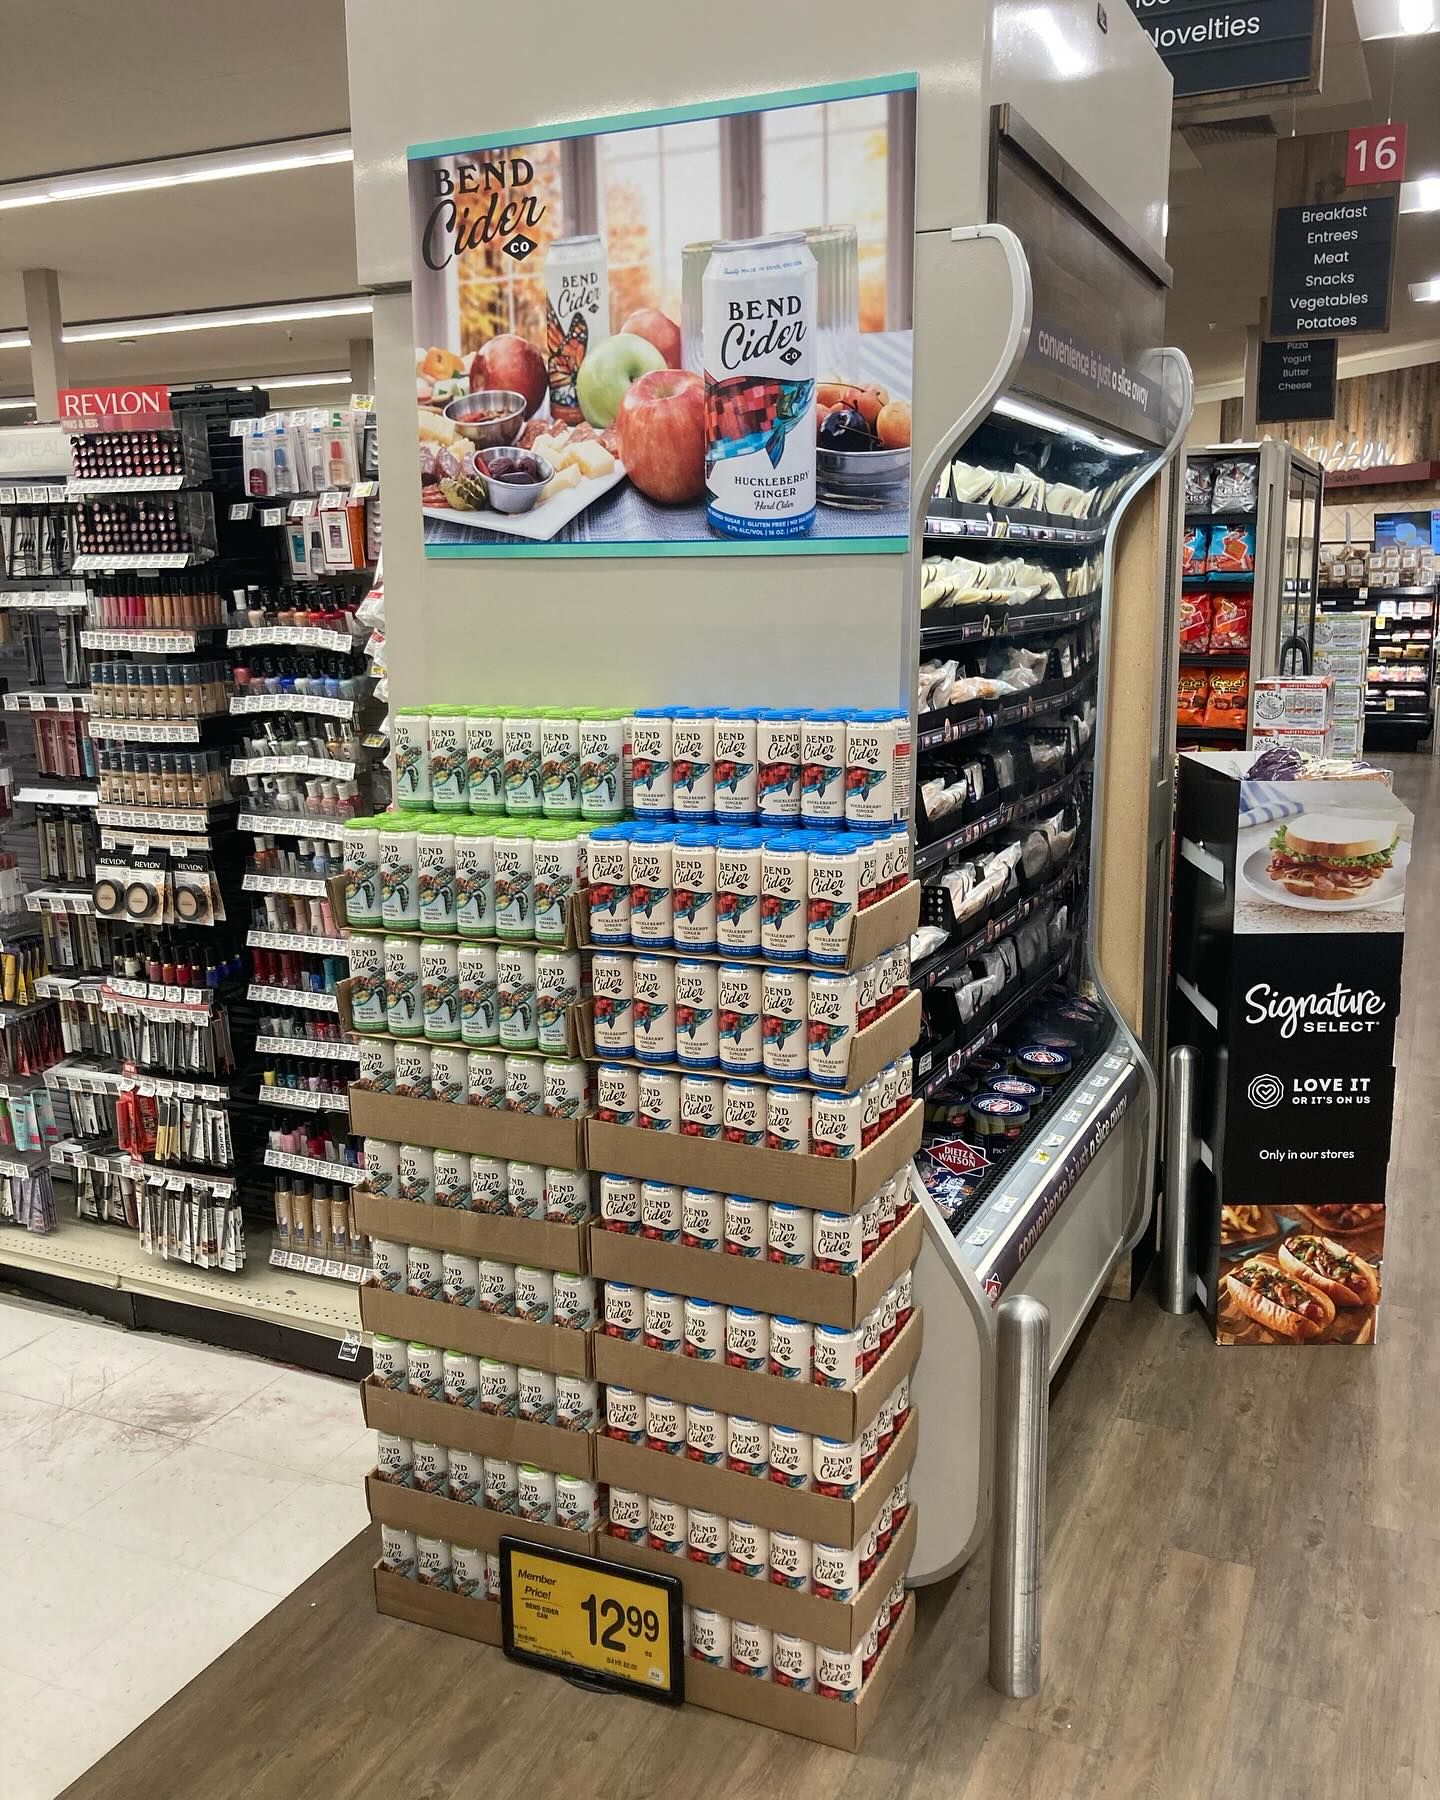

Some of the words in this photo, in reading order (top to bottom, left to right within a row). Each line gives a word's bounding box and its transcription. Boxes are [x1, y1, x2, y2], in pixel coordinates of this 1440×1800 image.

[1144, 15, 1260, 48] Novelties
[1355, 137, 1396, 171] 16
[433, 159, 533, 196] BEND
[1302, 206, 1367, 223] Breakfast
[423, 192, 546, 270] Cider
[1308, 230, 1358, 244] Entrees
[511, 242, 529, 253] CO
[1314, 251, 1349, 264] Meat
[562, 272, 598, 288] BEND
[1306, 272, 1354, 286] Snacks
[558, 287, 601, 318] Cider
[728, 296, 801, 320] BEND
[1290, 293, 1368, 311] Vegetables
[1297, 316, 1357, 330] Potatoes
[721, 320, 807, 369] Cider
[786, 352, 797, 360] CO
[1283, 354, 1312, 365] Yogurt
[1039, 331, 1089, 376] convenience
[1090, 351, 1096, 380] is
[1097, 354, 1111, 389] just
[1112, 371, 1117, 390] a
[1118, 368, 1131, 398] slice
[1132, 382, 1149, 412] away
[1283, 368, 1310, 377] Butter
[1279, 382, 1312, 391] Cheese
[65, 392, 160, 416] REVLON
[735, 471, 809, 486] HUCKLEBERRY
[754, 488, 796, 498] GINGER
[754, 501, 774, 510] Hard
[776, 500, 793, 510] Cider
[635, 731, 659, 740] BEND
[718, 732, 744, 740] BEND
[806, 735, 833, 743] BEND
[851, 738, 878, 746] BEND
[633, 739, 662, 755] Cider
[717, 741, 746, 757] Cider
[804, 744, 835, 761] Cider
[848, 746, 880, 764] Cider
[594, 855, 622, 863] BEND
[676, 860, 701, 869] BEND
[178, 863, 203, 871] REVLON
[592, 862, 625, 880] Cider
[720, 863, 747, 871] BEND
[814, 869, 842, 878] BEND
[674, 868, 704, 885] Cider
[718, 870, 749, 889] Cider
[811, 877, 845, 895] Cider
[722, 982, 748, 991] BEND
[720, 990, 750, 1006] Cider
[811, 992, 838, 1001] BEND
[810, 1001, 841, 1018] Cider
[1246, 983, 1385, 1038] Signature
[1303, 1022, 1375, 1032] SELECT
[1294, 1078, 1343, 1092] LOVE
[1350, 1078, 1370, 1091] IT
[685, 1093, 711, 1102] BEND
[1311, 1096, 1332, 1104] IT'S
[1337, 1096, 1352, 1104] ON
[1356, 1096, 1370, 1104] US
[683, 1102, 714, 1118] Cider
[818, 1112, 845, 1122] BEND
[816, 1120, 848, 1139] Cider
[944, 1146, 967, 1158] DIETZ
[1260, 1150, 1285, 1162] Only
[1288, 1150, 1297, 1159] in
[1300, 1151, 1318, 1159] our
[1321, 1150, 1355, 1158] stores
[938, 1152, 976, 1167] WATSON
[1019, 1180, 1067, 1263] convenience
[1065, 1166, 1074, 1188] is
[1072, 1145, 1090, 1181] just
[1090, 1141, 1094, 1158] a
[1095, 1119, 1110, 1150] slice
[1110, 1095, 1128, 1127] away
[609, 1192, 635, 1201] BEND
[606, 1200, 637, 1218] Cider
[821, 1230, 849, 1240] BEND
[818, 1239, 852, 1255] Cider
[730, 1328, 755, 1338] BEND
[728, 1336, 758, 1350] Cider
[824, 1457, 852, 1466] BEND
[820, 1465, 854, 1480] Cider
[818, 1559, 843, 1568] BEND
[518, 1569, 557, 1586] Member
[815, 1567, 846, 1582] Cider
[525, 1586, 551, 1600] Price!
[822, 1660, 850, 1670] BEND
[820, 1668, 853, 1683] Cider
